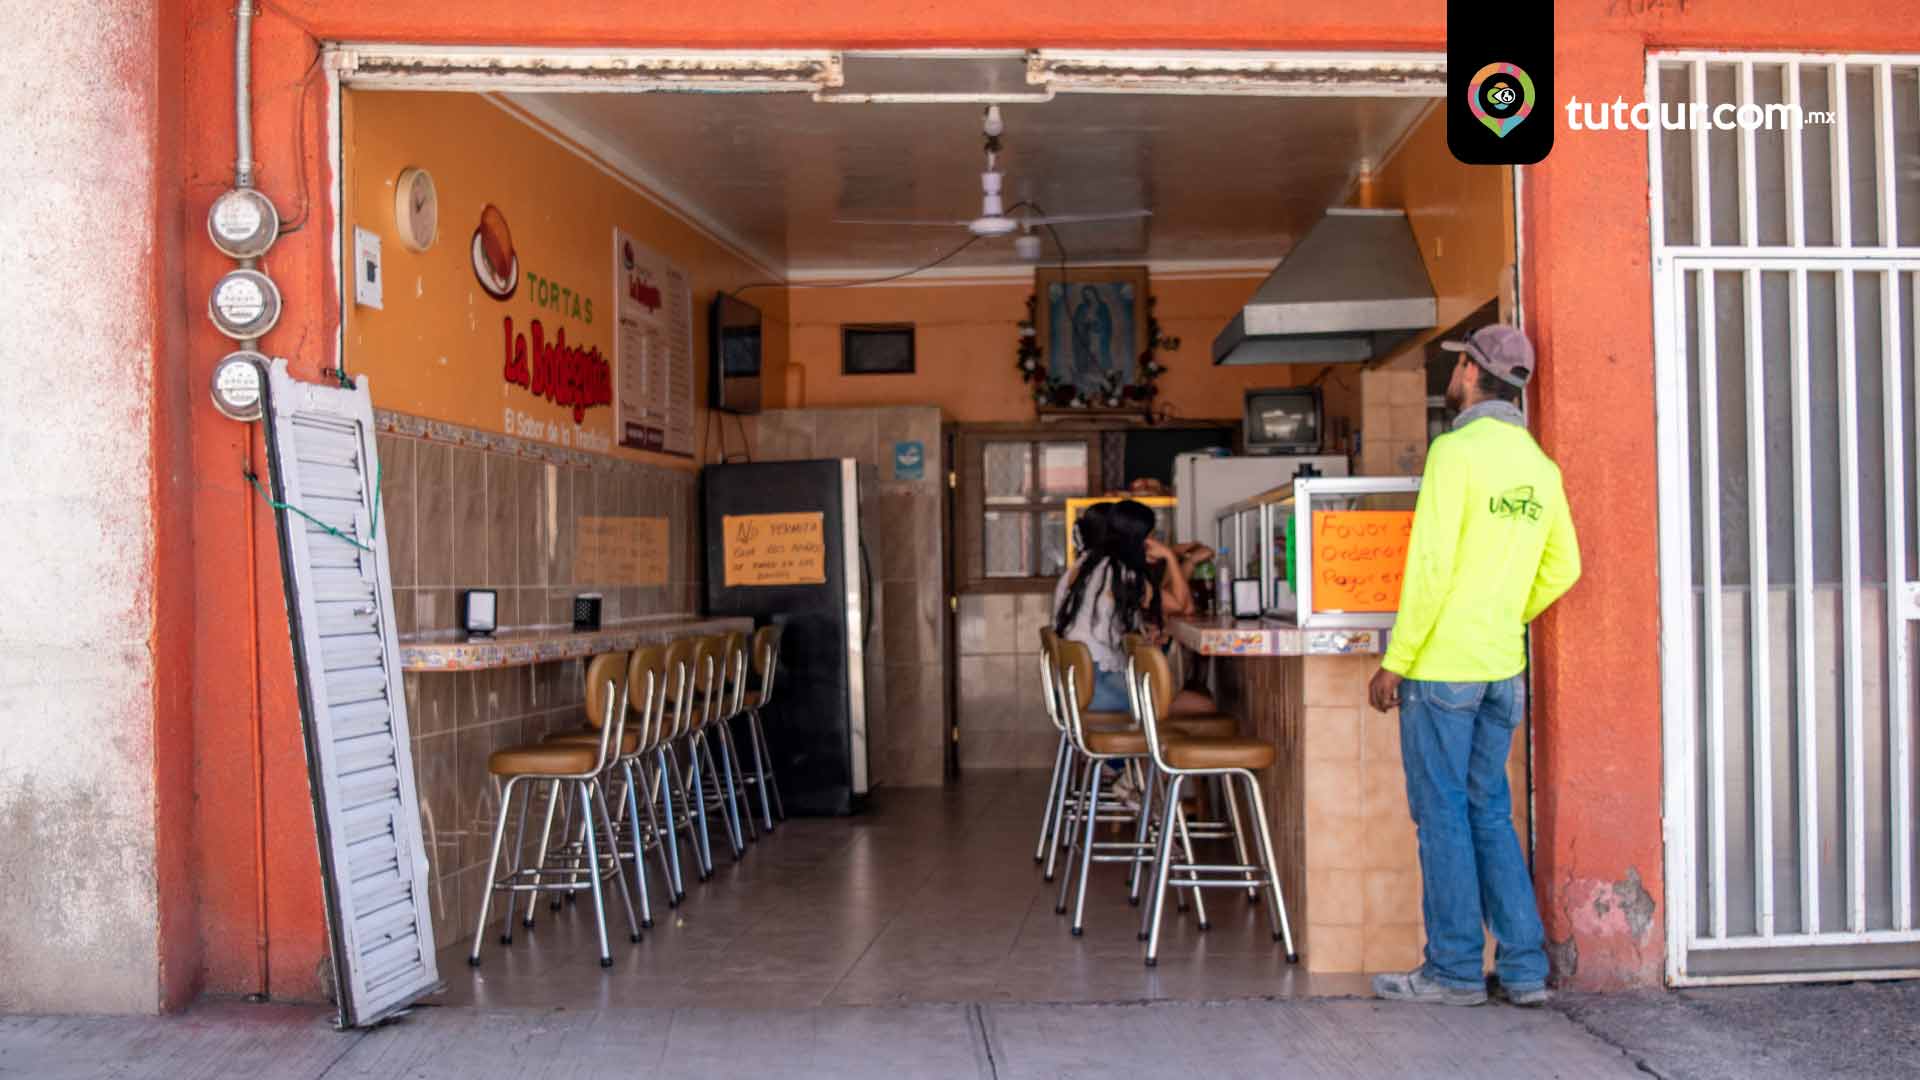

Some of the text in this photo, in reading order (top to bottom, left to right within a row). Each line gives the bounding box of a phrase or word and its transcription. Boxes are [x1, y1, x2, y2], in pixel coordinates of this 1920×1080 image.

[527, 272, 593, 324] TORTAS
[504, 315, 530, 390] La
[504, 407, 514, 433] El
[1321, 515, 1388, 539] Favor
